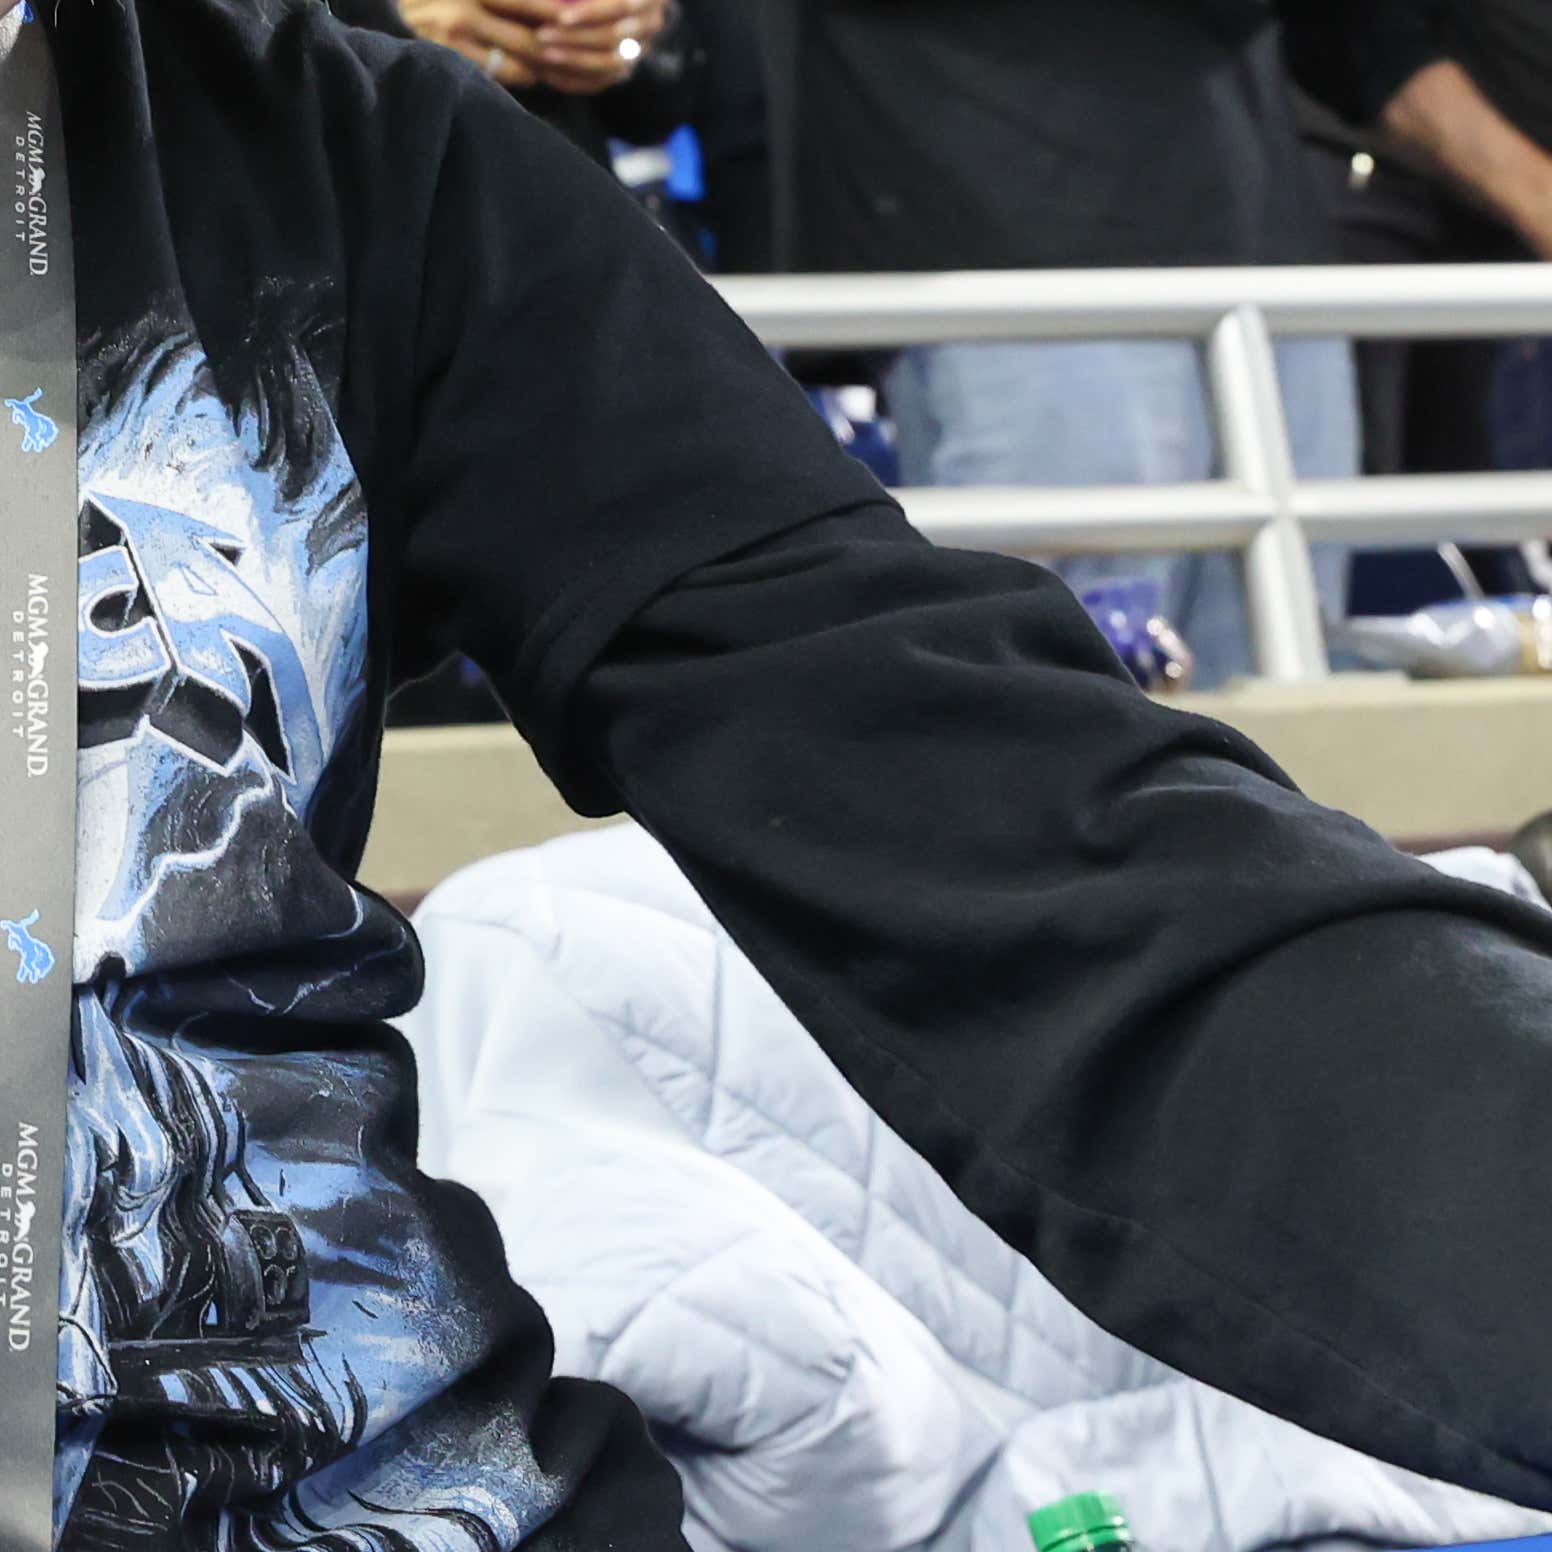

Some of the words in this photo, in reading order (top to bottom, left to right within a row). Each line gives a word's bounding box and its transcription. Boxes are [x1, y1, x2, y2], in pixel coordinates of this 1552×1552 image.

[26, 110, 45, 164] MGM
[14, 136, 26, 241] DETROIT
[28, 196, 48, 276] GRAND
[27, 574, 49, 639] MGM
[12, 610, 25, 739] DETROIT
[26, 679, 49, 778] GRAND
[15, 1121, 39, 1196] MGM
[7, 1242, 34, 1352] GRAND
